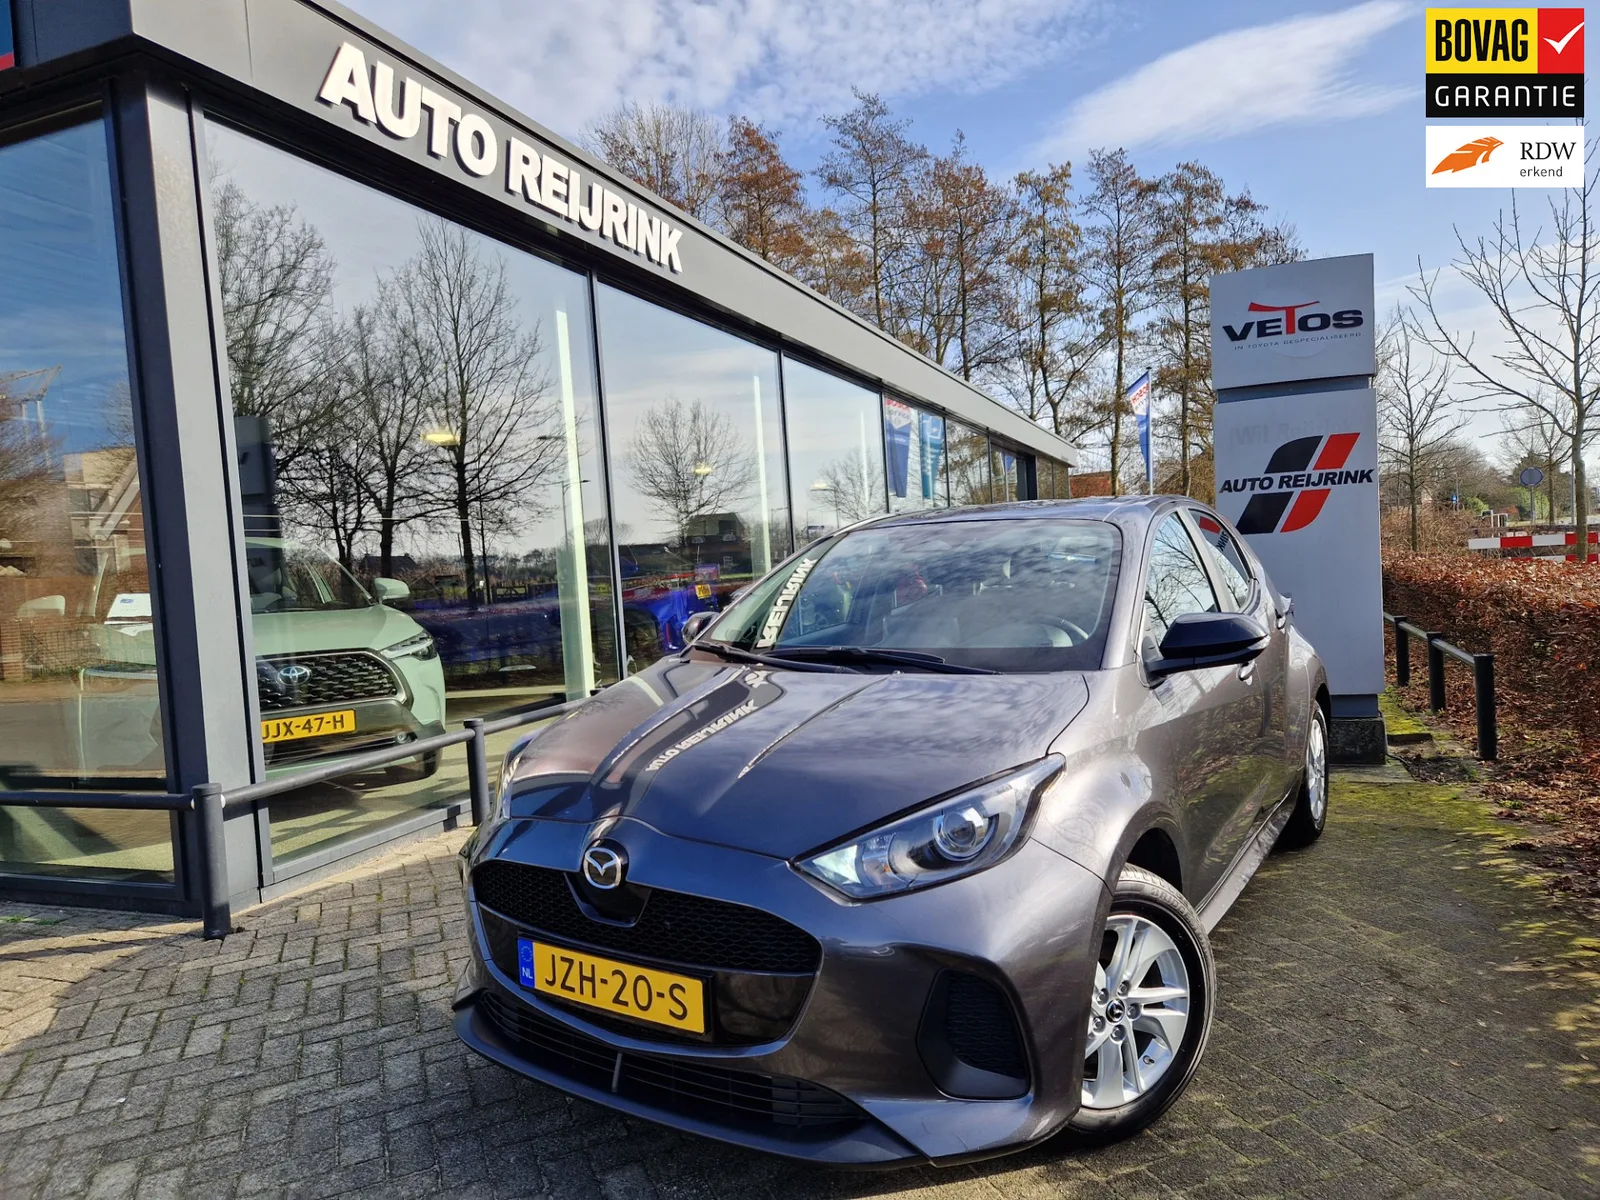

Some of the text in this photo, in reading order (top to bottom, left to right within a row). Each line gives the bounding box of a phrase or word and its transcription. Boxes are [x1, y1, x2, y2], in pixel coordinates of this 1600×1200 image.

[317, 41, 683, 273] AUTO REIJRINK
[1222, 300, 1364, 342] VETOS
[1247, 341, 1280, 350] TOYOTA
[1283, 332, 1362, 345] GESPECIALISEERD
[1219, 468, 1375, 494] AUTO REIJRINK
[521, 966, 534, 980] NL
[545, 954, 688, 1021] JZH-20-S
